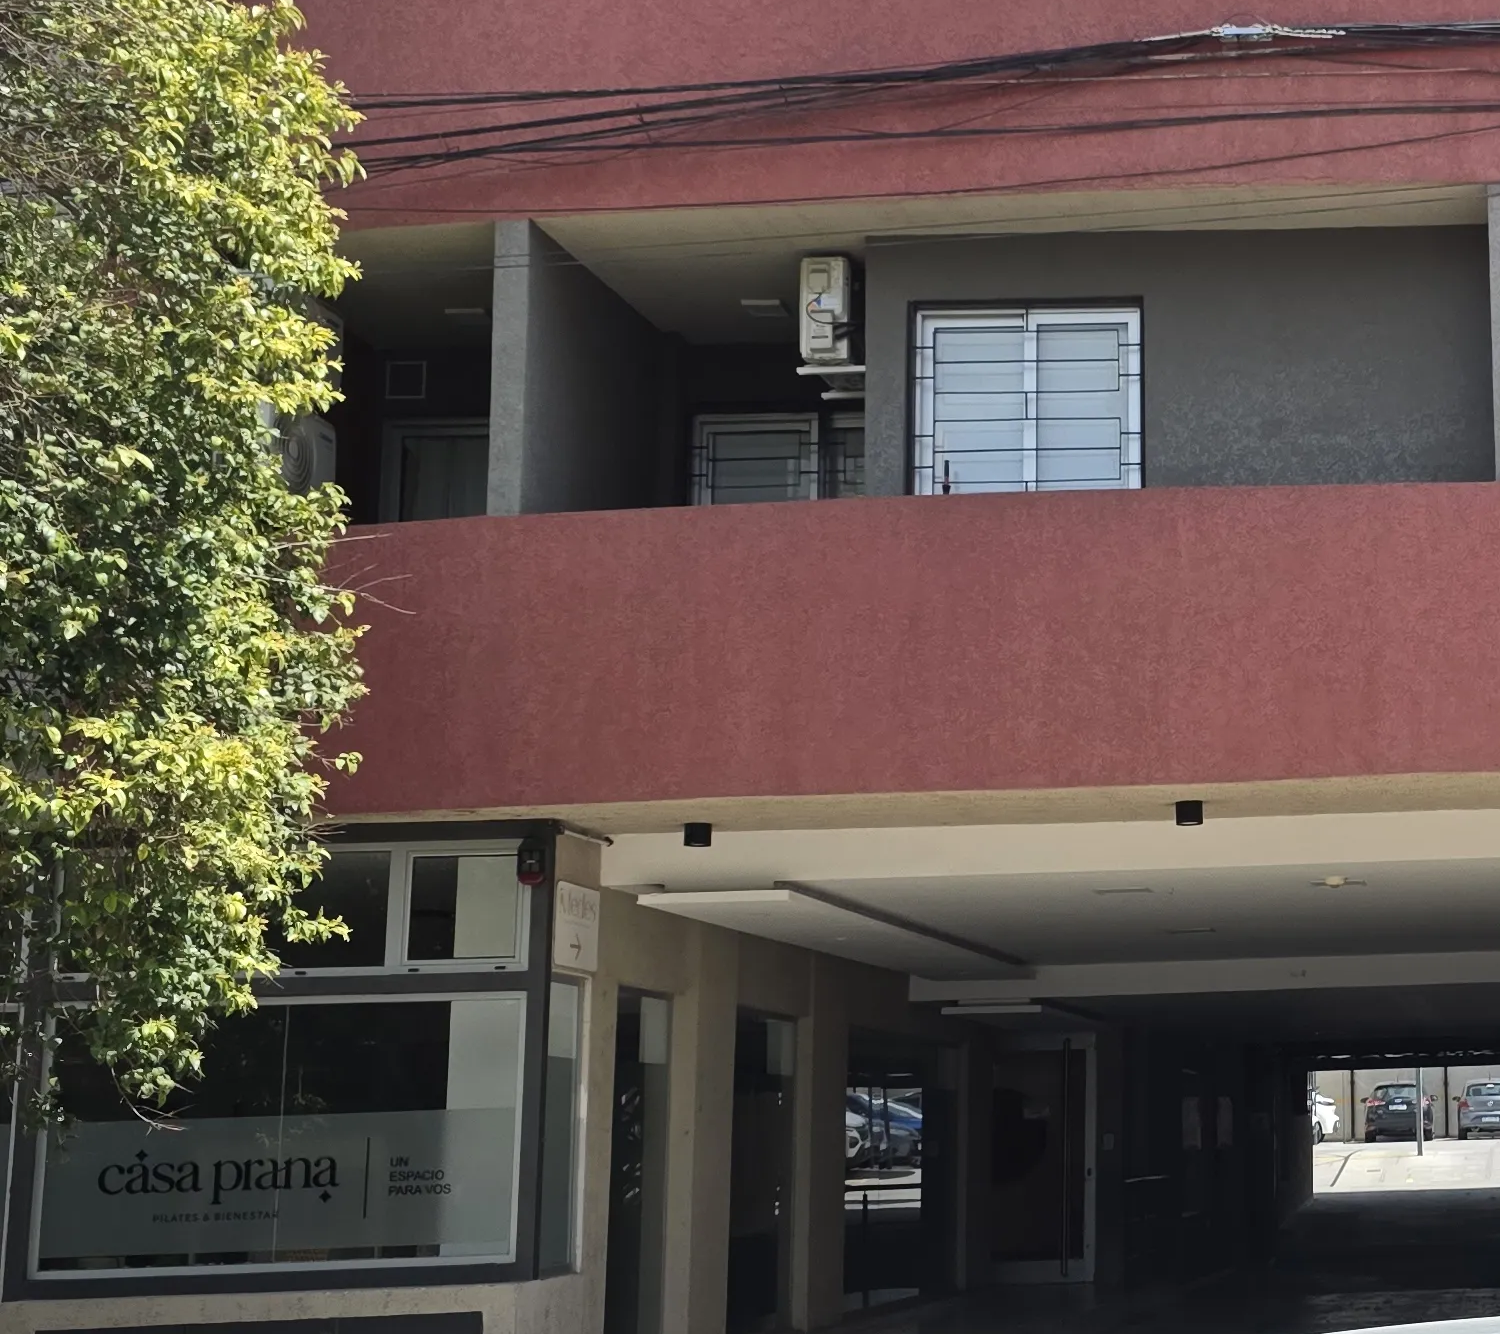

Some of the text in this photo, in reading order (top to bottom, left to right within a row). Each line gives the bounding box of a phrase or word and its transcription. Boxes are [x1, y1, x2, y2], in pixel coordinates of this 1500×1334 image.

[389, 1157, 409, 1168] UN
[389, 1169, 445, 1182] ESPACIO
[388, 1183, 452, 1196] PARA VOS
[152, 1212, 200, 1224] PILATES
